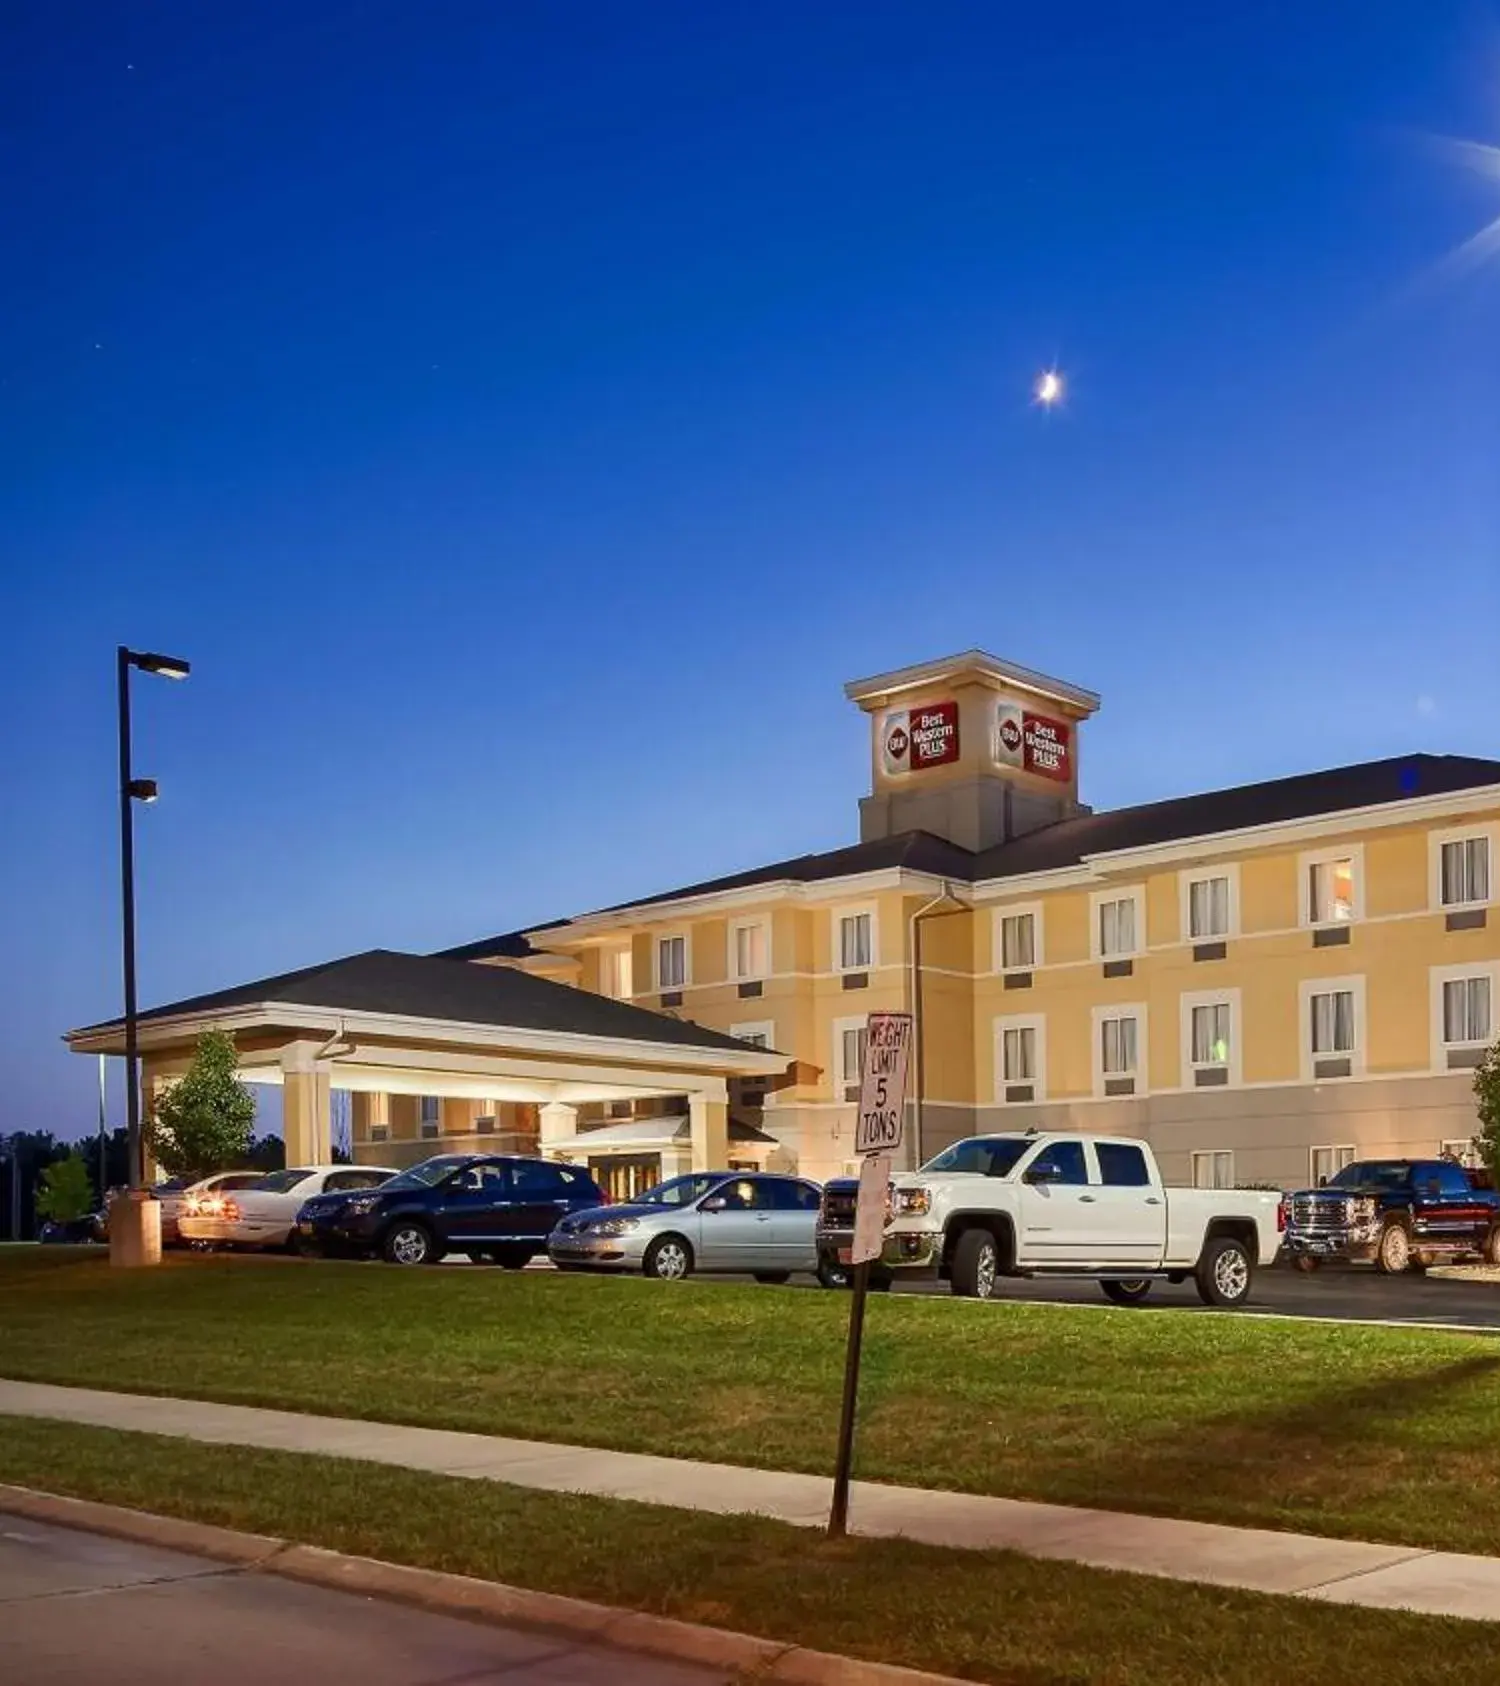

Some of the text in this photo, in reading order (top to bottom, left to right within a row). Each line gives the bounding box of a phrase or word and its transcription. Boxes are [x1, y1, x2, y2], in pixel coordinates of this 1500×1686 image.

[921, 712, 944, 728] Best
[1035, 721, 1057, 741] Best
[912, 724, 953, 743] Western
[1025, 731, 1065, 756] Western
[920, 739, 945, 756] PLUS
[1033, 748, 1059, 768] PLUS
[870, 1021, 910, 1047] WEIGHT
[871, 1048, 899, 1074] LIMIT
[875, 1077, 888, 1108] 5
[863, 1111, 897, 1144] TONS
